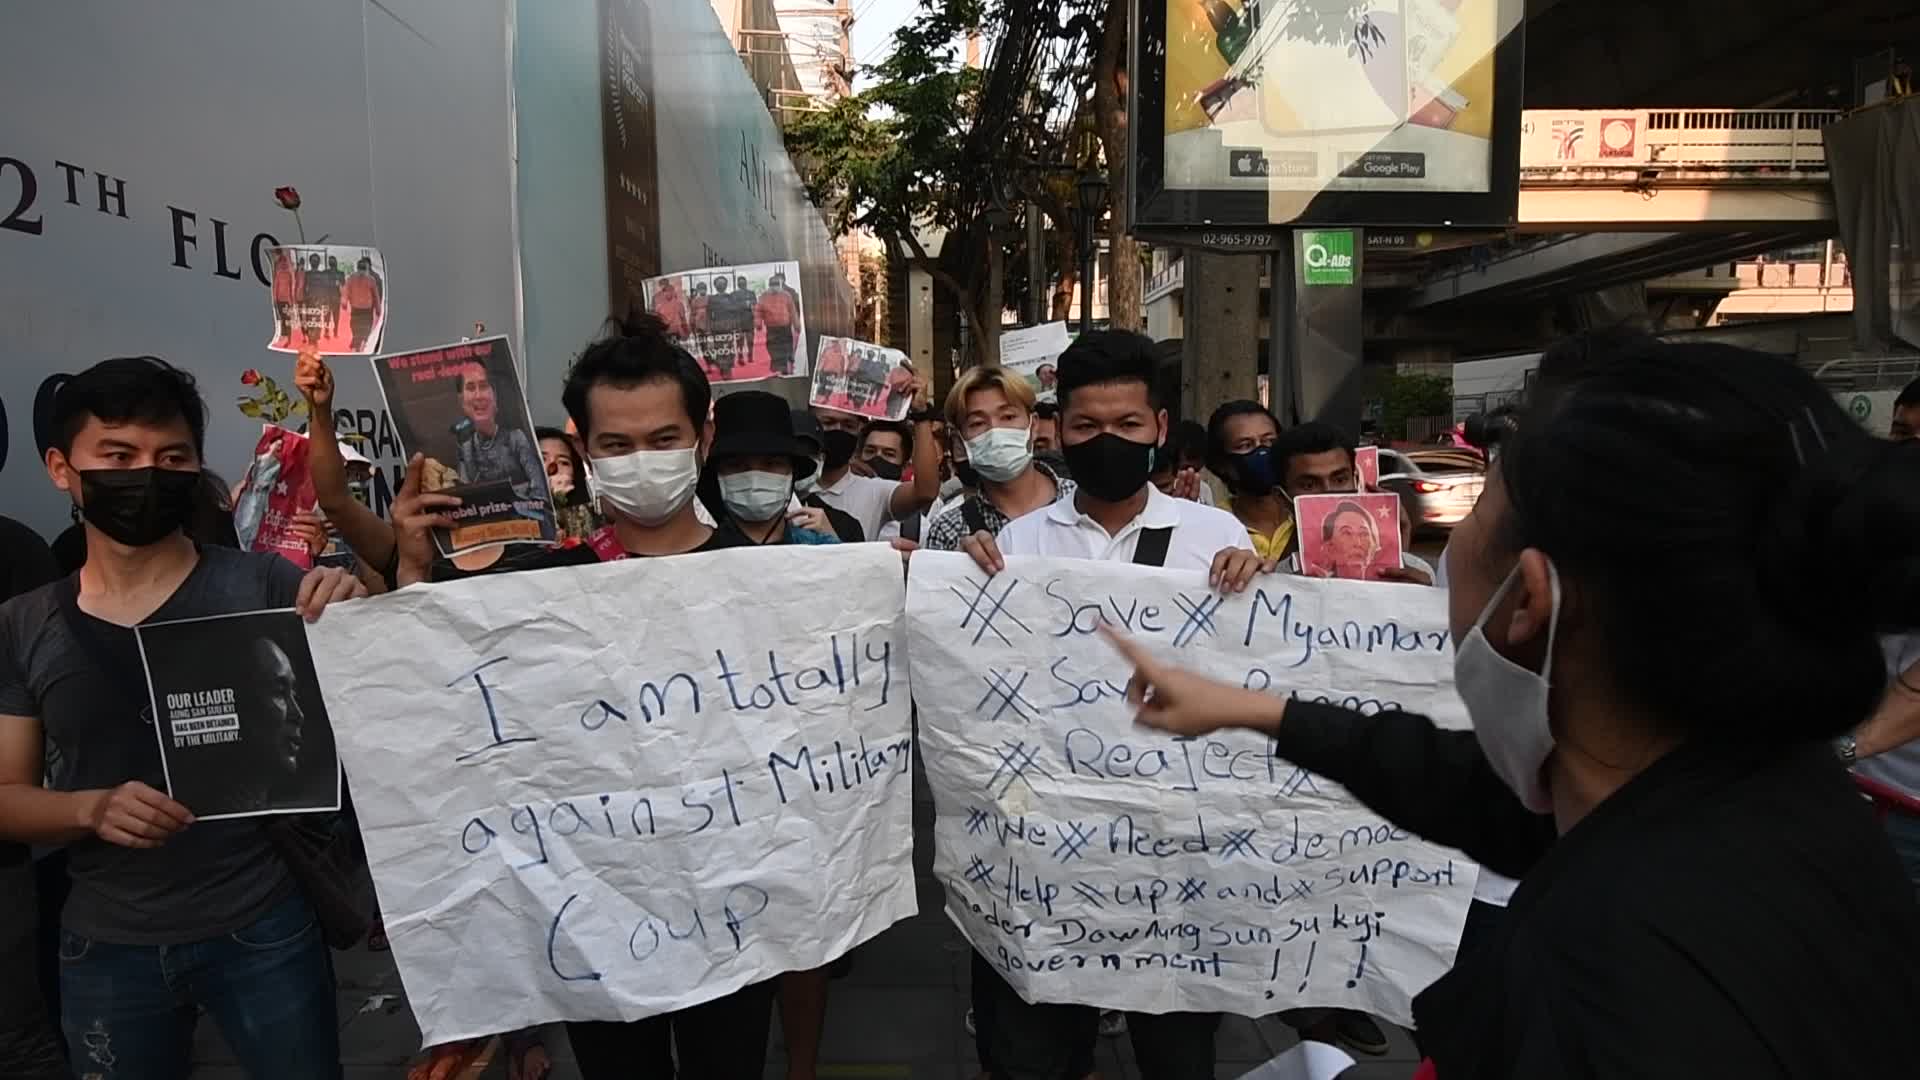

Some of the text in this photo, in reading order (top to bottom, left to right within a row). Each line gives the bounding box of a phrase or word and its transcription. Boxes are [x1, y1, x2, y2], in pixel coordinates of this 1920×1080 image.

[1364, 162, 1421, 175] Google Play
[166, 204, 280, 288] FLO
[1202, 233, 1272, 246] 02-965-9797
[1244, 588, 1449, 668] Myanmar
[166, 688, 236, 709] OUR LEADER
[1051, 656, 1133, 709] Sav
[447, 656, 536, 761] I
[1272, 815, 1411, 865] democ
